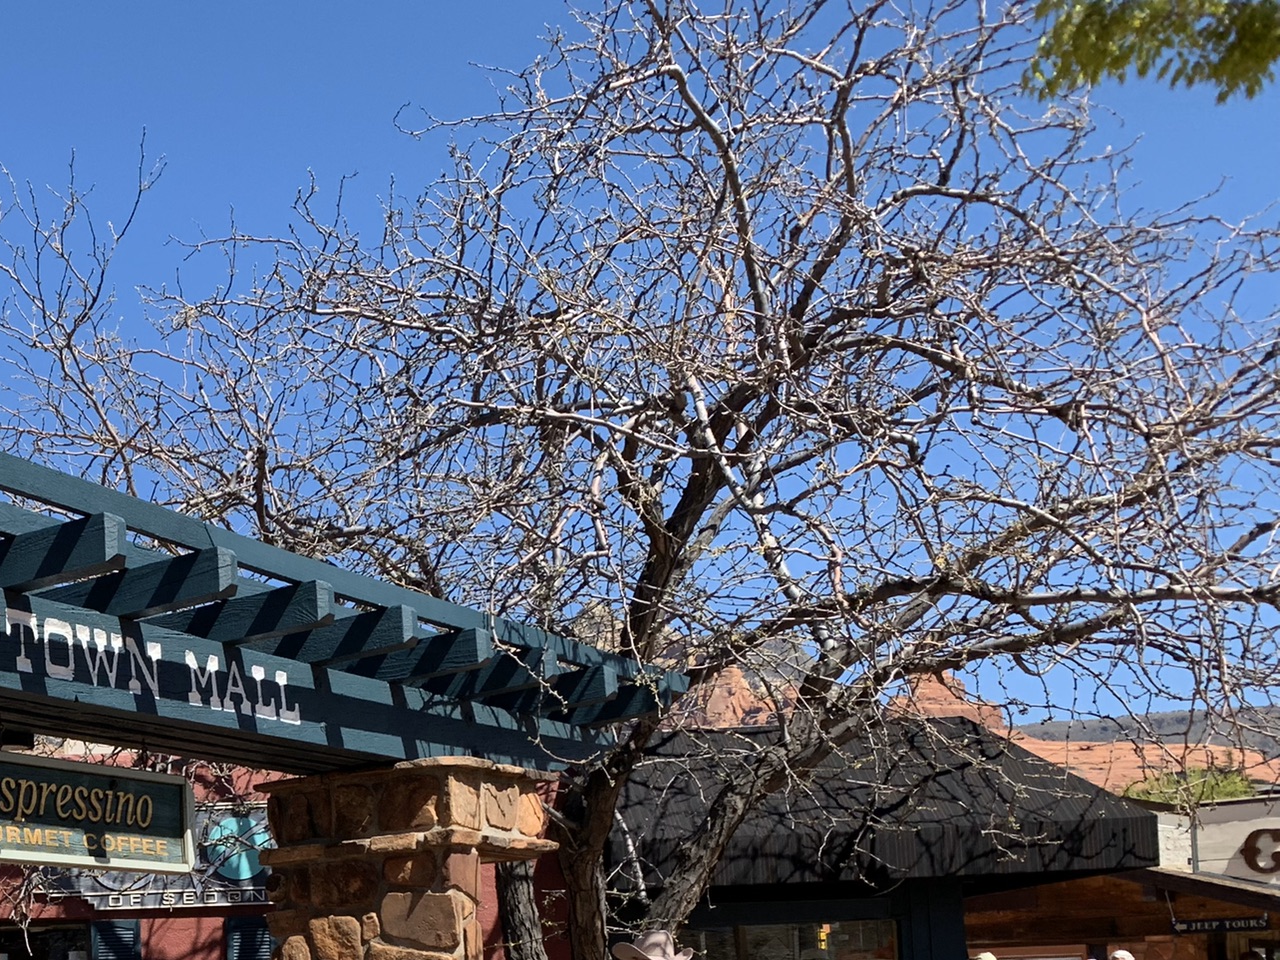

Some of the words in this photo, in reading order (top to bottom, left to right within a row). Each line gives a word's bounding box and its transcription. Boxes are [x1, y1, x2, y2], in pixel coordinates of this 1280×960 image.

[184, 649, 302, 725] MALL
[82, 831, 170, 857] COFFEE
[108, 894, 141, 907] OF
[162, 890, 266, 906] SEDON
[1189, 921, 1220, 931] JEEP
[1225, 919, 1267, 929] TOURS
